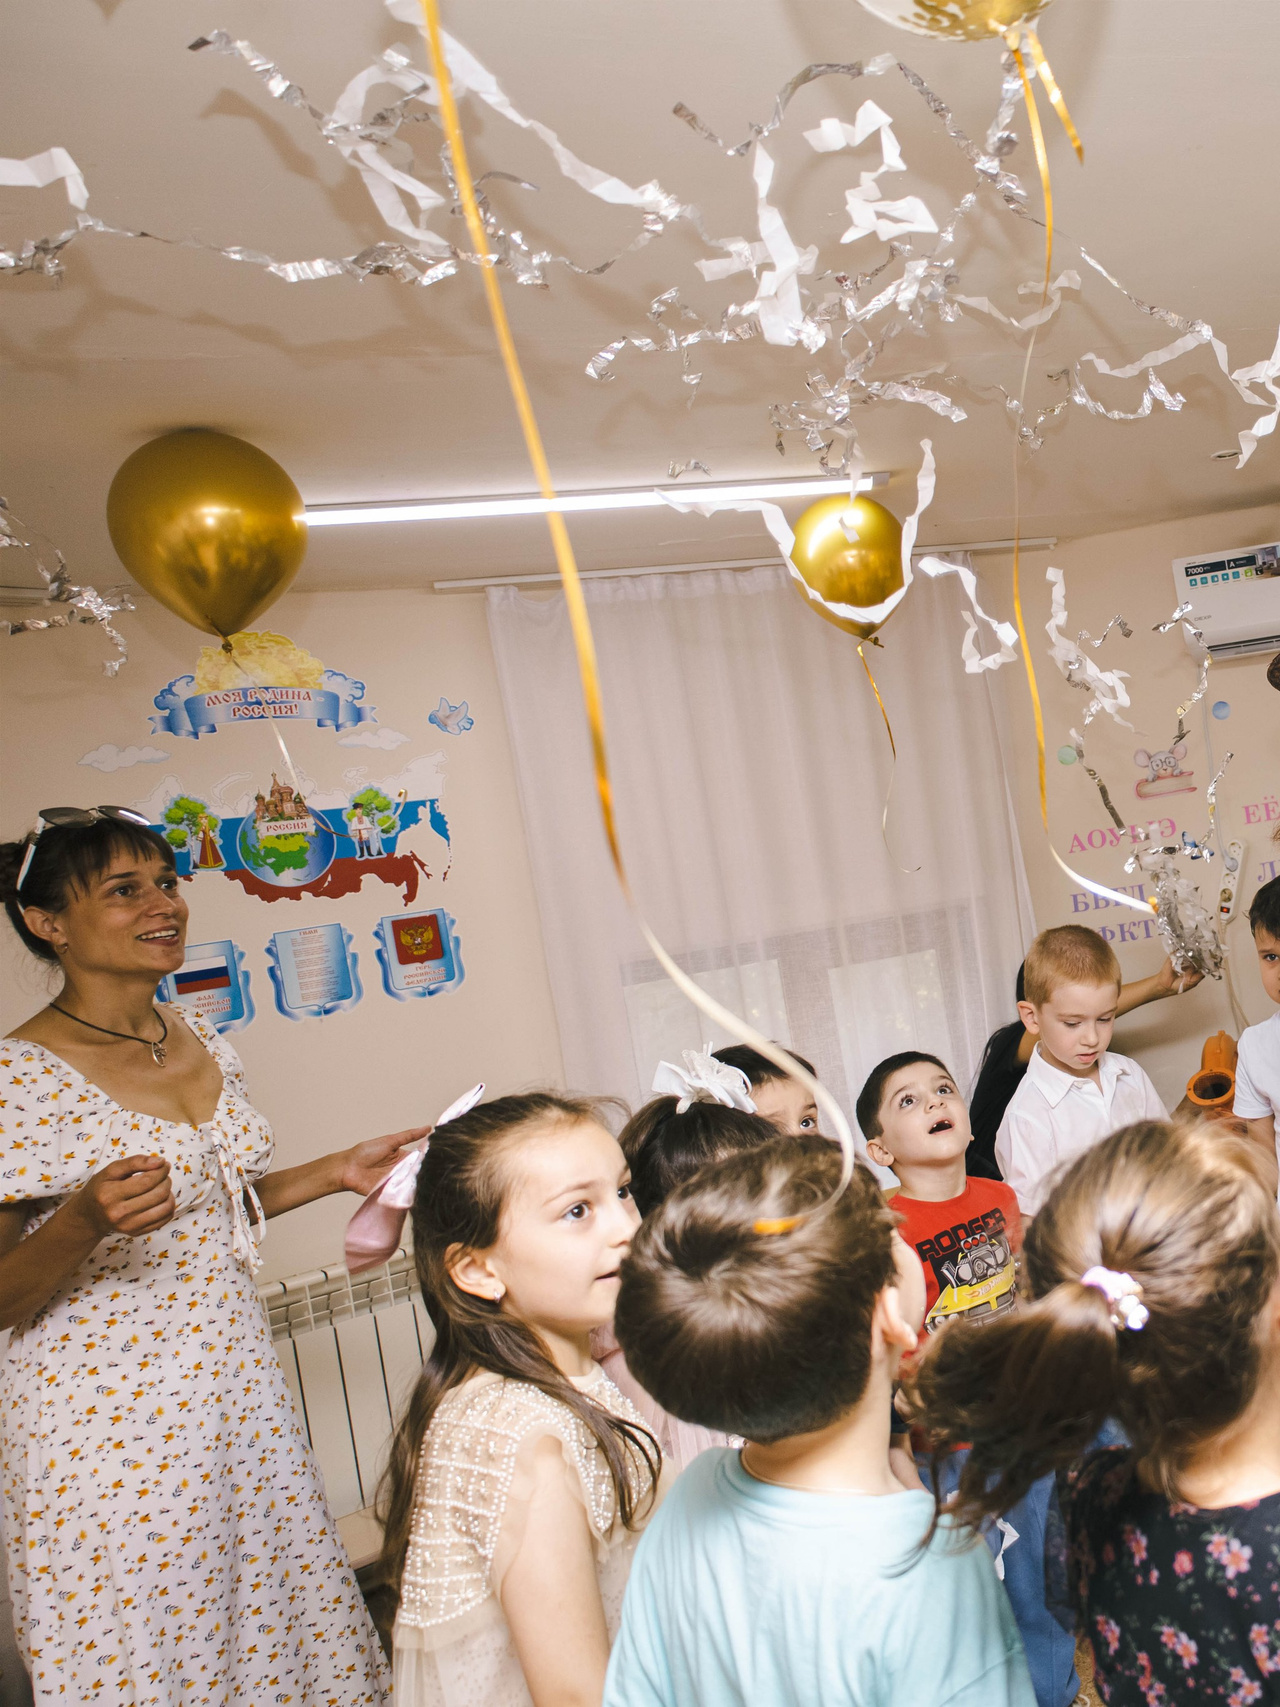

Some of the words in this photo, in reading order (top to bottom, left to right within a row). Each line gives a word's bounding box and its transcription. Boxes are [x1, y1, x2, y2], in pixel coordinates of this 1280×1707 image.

[1187, 567, 1204, 575] 7000
[206, 690, 243, 707] МОЯ
[266, 821, 308, 832] РОССИЯ
[915, 1207, 1006, 1263] RODGER
